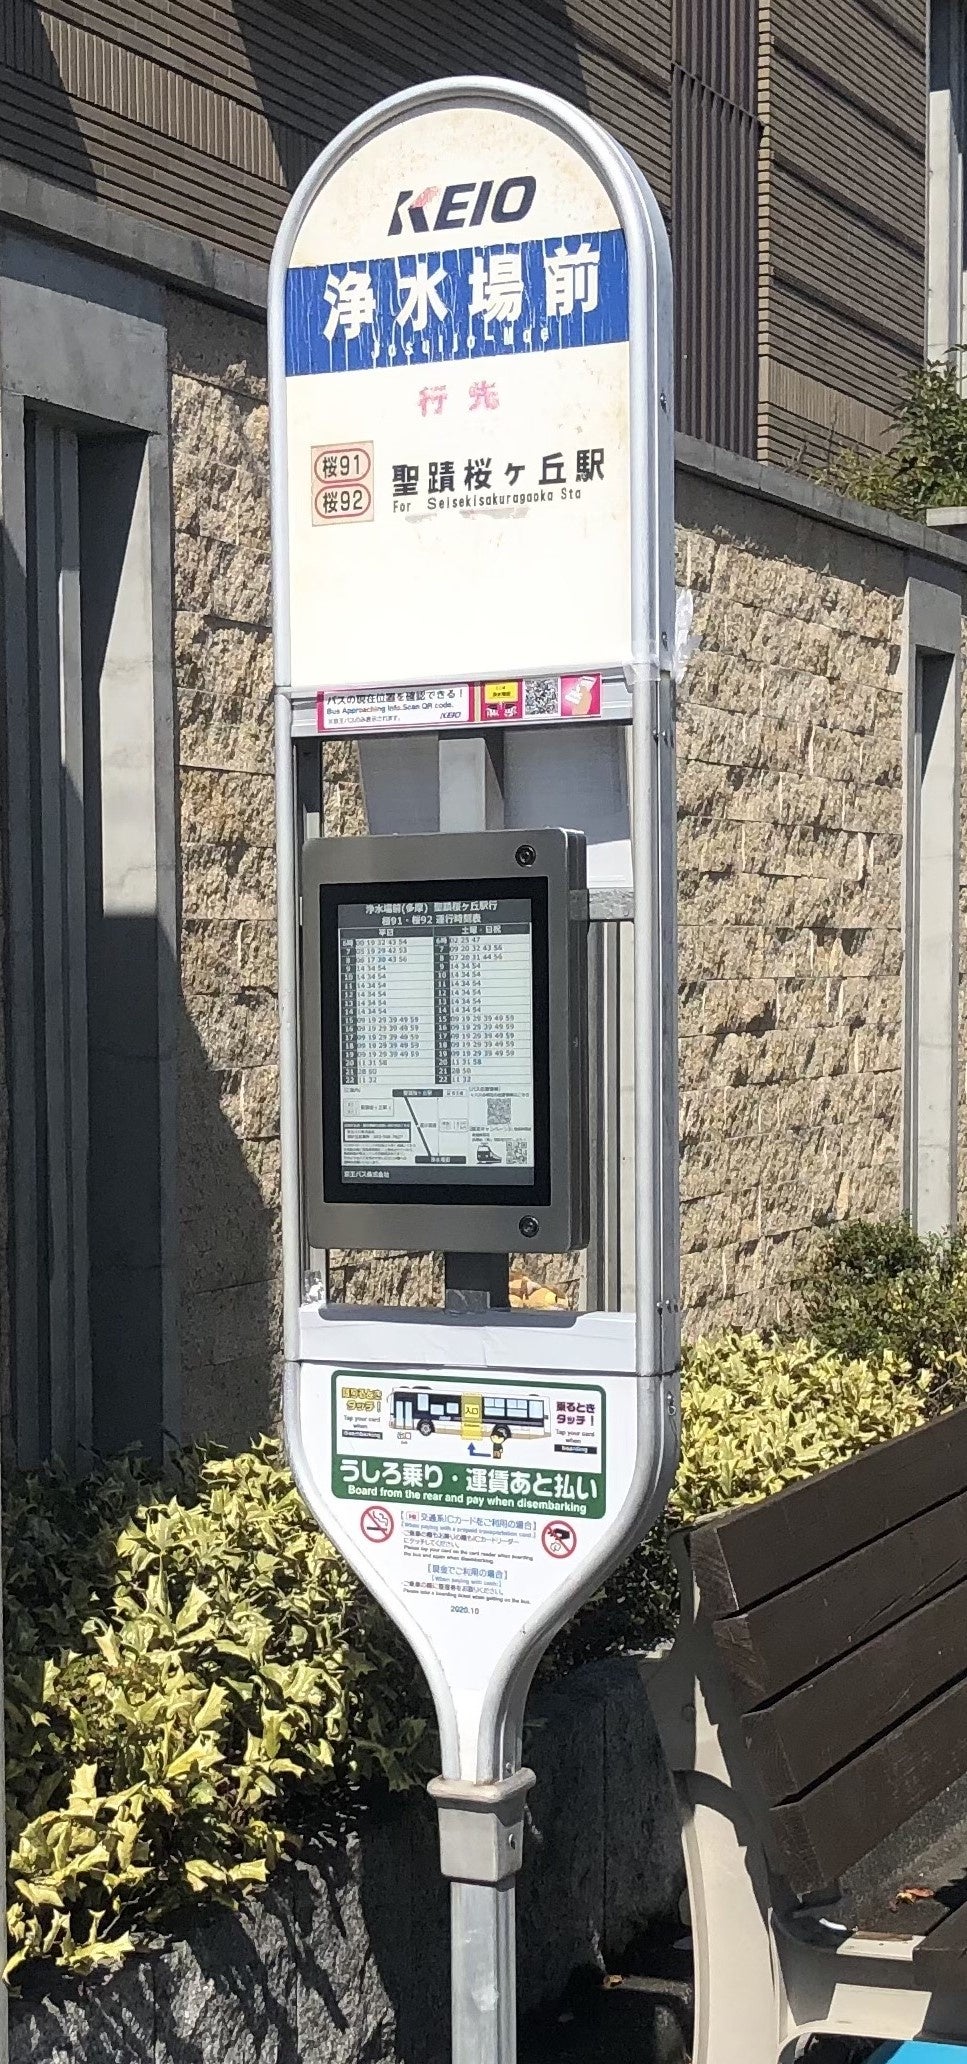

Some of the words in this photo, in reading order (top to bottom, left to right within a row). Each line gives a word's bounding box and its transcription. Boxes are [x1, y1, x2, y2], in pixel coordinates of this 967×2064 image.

[387, 175, 536, 236] KEIO
[322, 241, 600, 341] 浄水場前
[418, 380, 500, 417] 行先
[322, 454, 361, 478] 桜91
[392, 448, 604, 497] 聖蹟桜ヶ丘駅
[322, 489, 363, 514] 桜92
[393, 500, 411, 513] For
[427, 490, 553, 510] Seisekisakuragaoka
[561, 488, 581, 500] Sta
[327, 707, 340, 715] Bus
[342, 706, 385, 714] Approaching
[465, 1406, 479, 1415] 入口
[556, 1401, 595, 1414] 乗るとき
[556, 1414, 594, 1426] タッチ！
[340, 1459, 597, 1499] うしろ乗り・運賃あと払い
[348, 1485, 377, 1497] Board
[380, 1487, 402, 1498] from
[405, 1488, 420, 1499] the
[423, 1491, 443, 1501] rear
[445, 1492, 464, 1503] and
[466, 1496, 485, 1507] pay
[487, 1495, 514, 1507] when
[517, 1499, 587, 1515] disembarking
[451, 1605, 479, 1614] 2020.10
